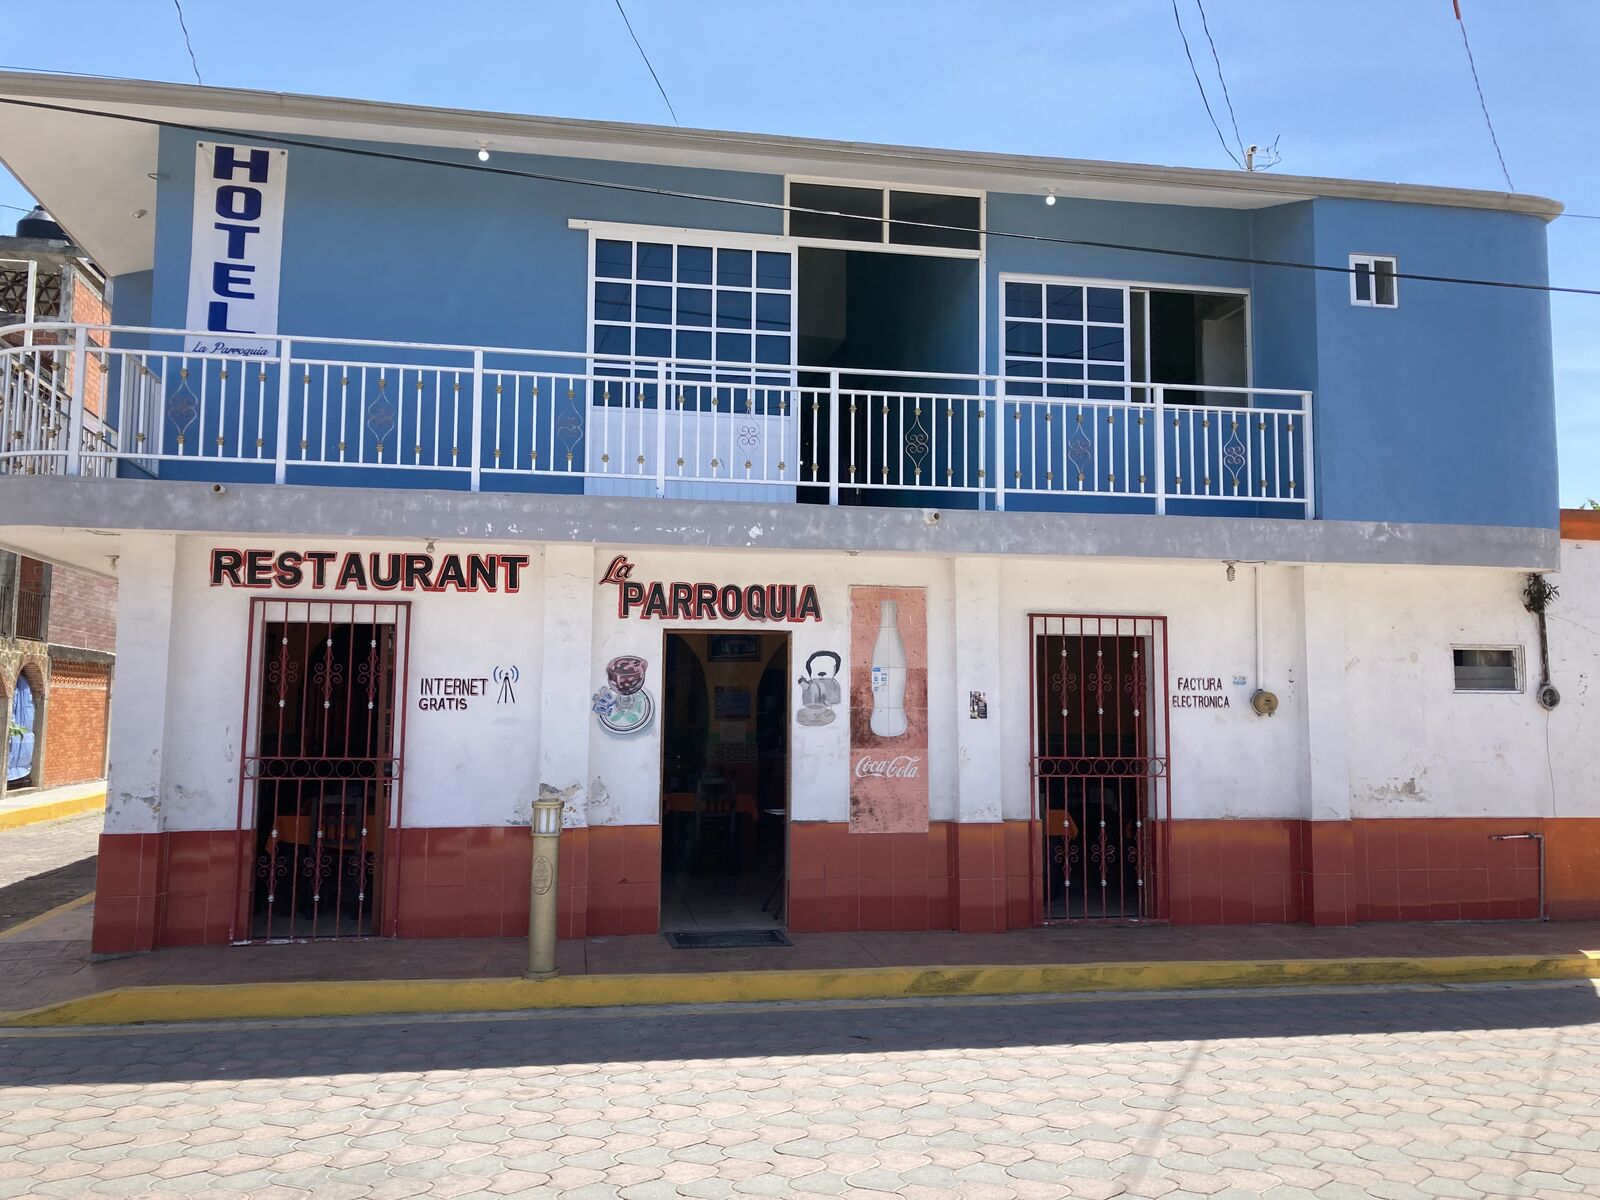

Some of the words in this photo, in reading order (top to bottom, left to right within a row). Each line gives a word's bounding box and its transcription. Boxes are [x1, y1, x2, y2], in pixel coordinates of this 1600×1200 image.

[207, 145, 270, 334] HOTEL
[192, 341, 208, 354] La
[209, 342, 269, 357] Parroquia
[210, 548, 530, 593] RESTAURANT
[598, 554, 635, 585] La
[618, 581, 823, 623] PARROQUIA
[420, 678, 489, 696] INTERNET
[1177, 677, 1223, 691] FACTURA
[418, 697, 468, 711] GRATIS
[1172, 695, 1230, 708] ELECTRONICA
[855, 755, 921, 778] Coca-Cola
